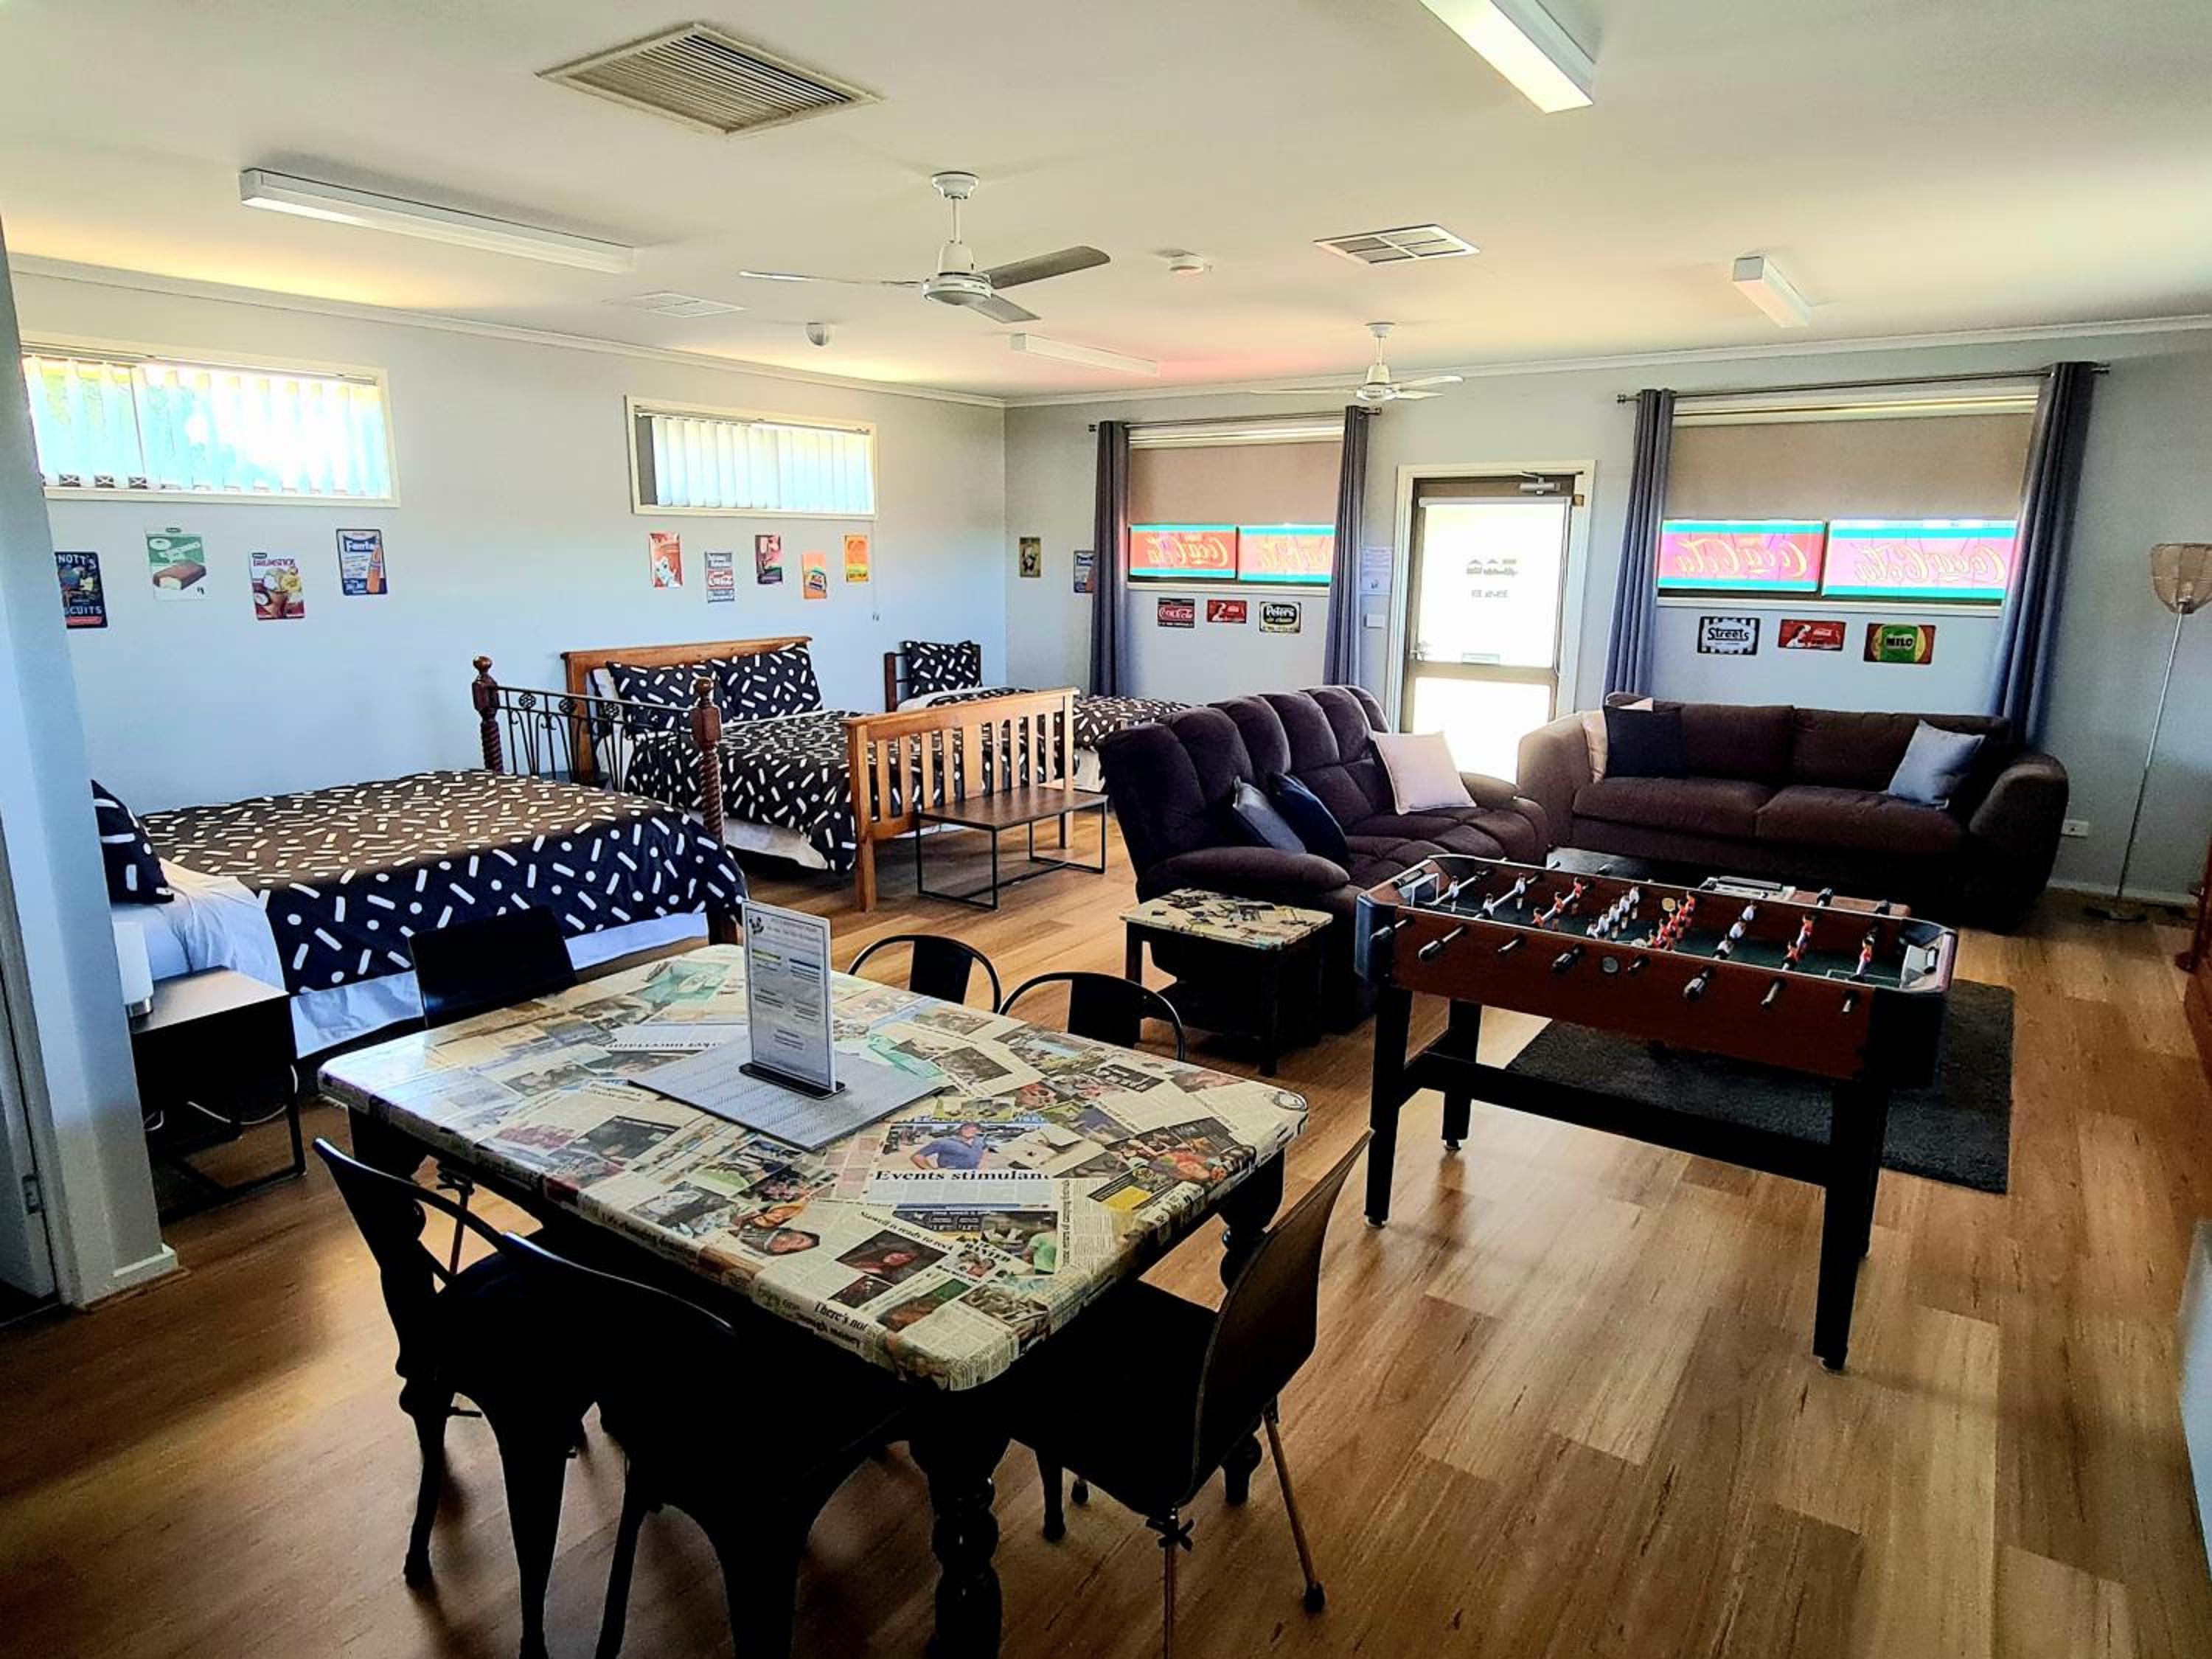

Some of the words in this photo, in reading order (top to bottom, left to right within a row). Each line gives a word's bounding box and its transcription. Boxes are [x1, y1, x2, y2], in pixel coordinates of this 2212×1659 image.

[1707, 627, 1750, 641] Streets
[1885, 637, 1913, 647] MILO
[875, 1170, 945, 1180] Events
[814, 1301, 848, 1324] There's
